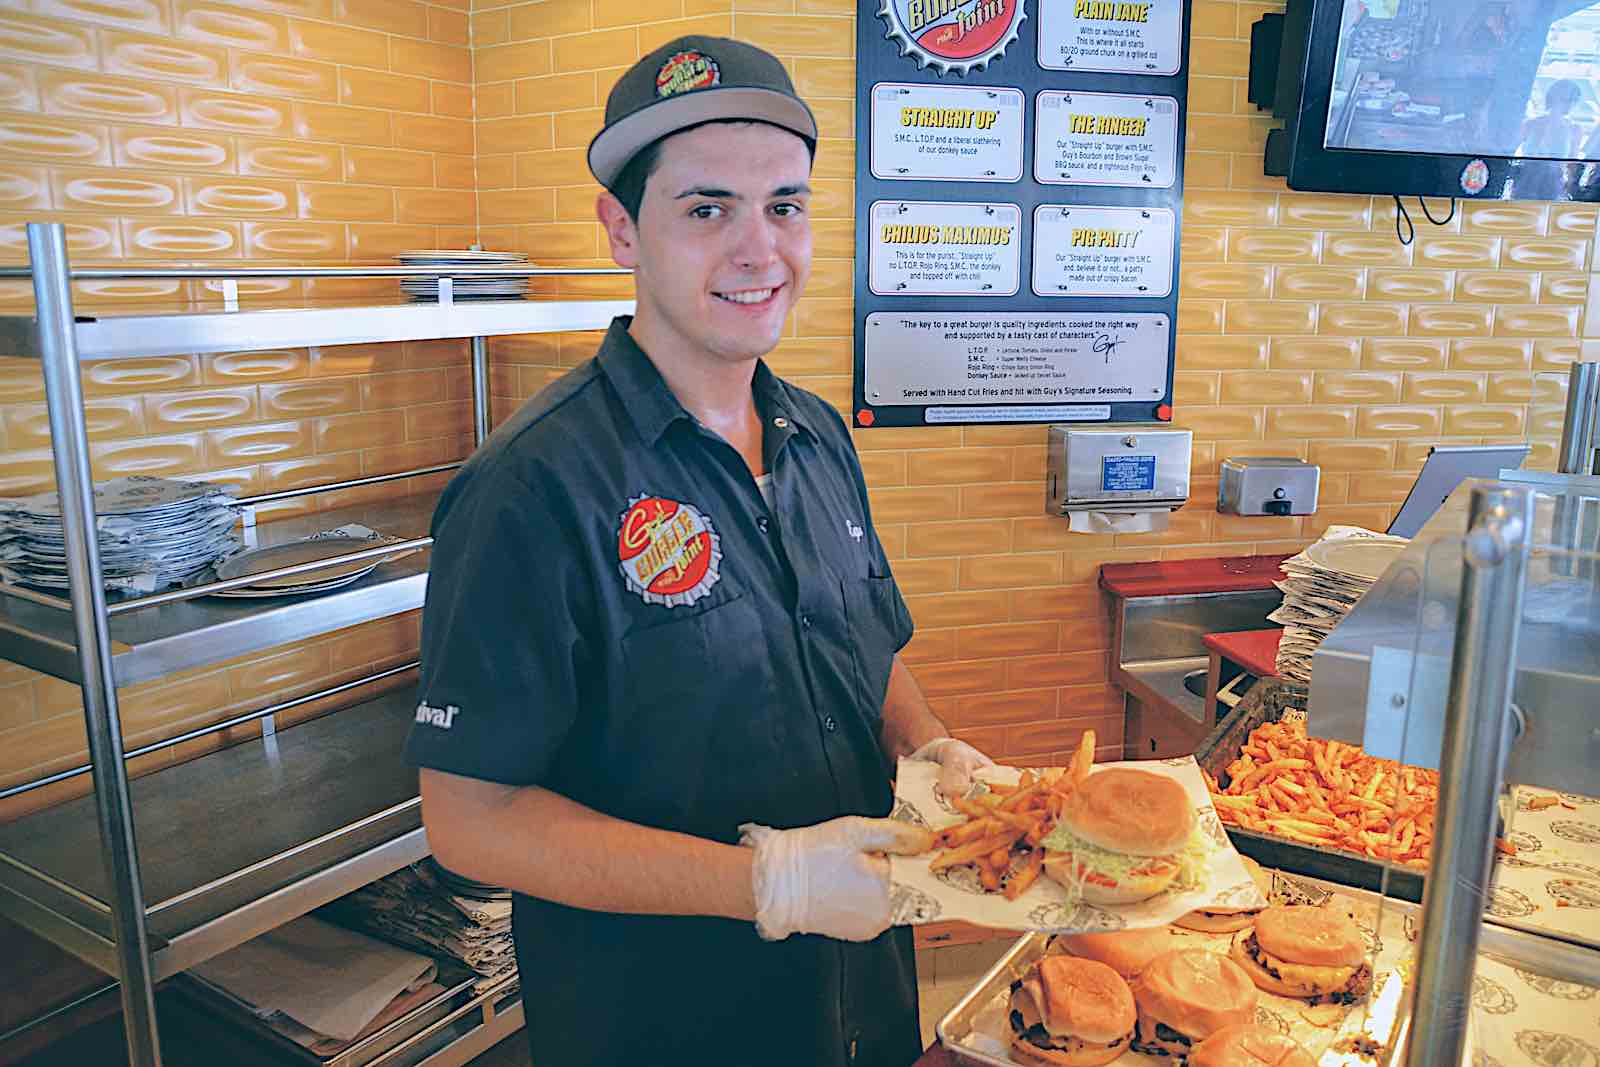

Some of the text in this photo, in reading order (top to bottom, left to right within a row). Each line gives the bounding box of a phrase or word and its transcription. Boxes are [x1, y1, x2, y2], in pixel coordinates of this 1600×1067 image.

[1073, 0, 1149, 22] PLAIN JANE
[1103, 28, 1123, 36] without
[1077, 37, 1088, 45] This
[1096, 39, 1112, 47] where
[1128, 41, 1144, 49] starts
[1060, 46, 1078, 55] 80/20
[1080, 48, 1099, 56] ground
[1100, 48, 1116, 56] chuck
[901, 107, 996, 130] STRAIGHT UP
[1070, 114, 1147, 137] THE RINGER
[936, 135, 946, 144] and
[953, 136, 971, 145] liberal
[972, 137, 1001, 148] slathering
[1056, 140, 1067, 149] Our
[1106, 143, 1123, 152] burger
[1125, 143, 1137, 151] with
[919, 145, 926, 153] of
[937, 146, 959, 156] donkey
[1080, 151, 1101, 160] Bourbon
[1104, 152, 1114, 160] and
[1116, 153, 1133, 161] Brown
[1055, 160, 1067, 169] BBQ
[1087, 161, 1097, 169] and
[1104, 163, 1129, 172] righteous
[881, 224, 1010, 245] CHILIUS MAXIMUS
[1071, 228, 1139, 248] PIG PATTY
[896, 251, 908, 259] This
[916, 251, 925, 260] for
[926, 251, 936, 260] the
[1056, 253, 1066, 262] Our
[1104, 255, 1121, 263] burger
[920, 262, 933, 271] Rojo
[969, 262, 980, 271] the
[981, 262, 1001, 272] donkey
[1064, 264, 1074, 272] and
[1075, 264, 1095, 272] believe
[1129, 266, 1143, 274] patty
[910, 272, 921, 280] and
[922, 272, 943, 281] topped
[944, 272, 953, 280] off
[955, 272, 968, 280] with
[1104, 275, 1119, 283] crispy
[900, 320, 917, 328] "The
[920, 320, 931, 330] key
[950, 320, 968, 329] great
[969, 320, 992, 329] burger
[994, 320, 1000, 328] is
[1002, 320, 1025, 330] quality
[1068, 320, 1093, 328] cooked
[1094, 320, 1105, 328] the
[1107, 320, 1124, 329] right
[1125, 321, 1138, 330] way
[959, 331, 996, 340] supported
[997, 331, 1005, 340] by
[1014, 331, 1031, 340] tasty
[1033, 331, 1048, 339] cast
[1050, 331, 1057, 339] of
[982, 363, 995, 372] Ring
[967, 372, 988, 380] Donkey
[903, 388, 928, 397] Served
[929, 388, 946, 396] with
[947, 388, 966, 396] Hand
[967, 388, 981, 396] Cut
[982, 388, 999, 396] Fries
[1015, 387, 1025, 395] hit
[1027, 387, 1042, 395] with
[1043, 387, 1062, 396] Guy's
[1064, 387, 1096, 396] Signature
